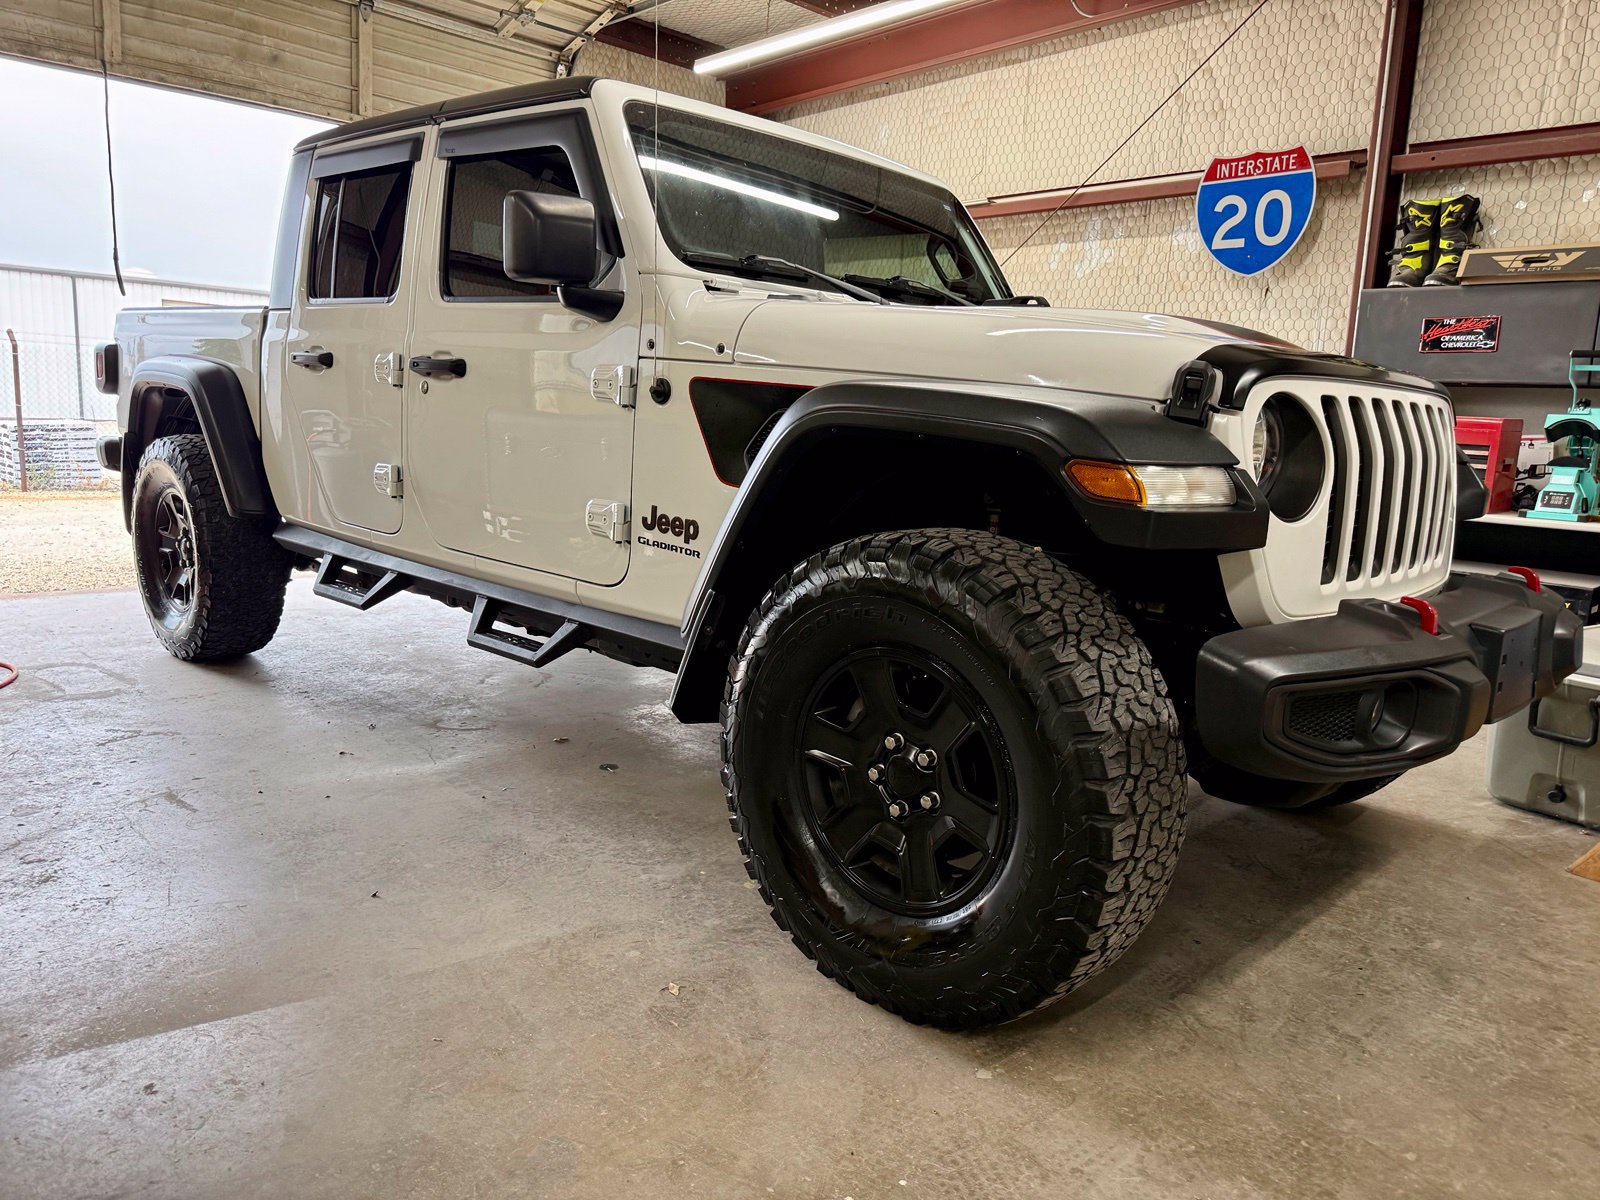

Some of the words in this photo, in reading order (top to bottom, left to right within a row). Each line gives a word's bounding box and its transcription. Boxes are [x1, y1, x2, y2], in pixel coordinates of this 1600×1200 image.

[1216, 153, 1298, 179] INTERSTATE
[1211, 189, 1292, 250] 20
[641, 504, 699, 544] Jeep
[637, 535, 701, 559] GLADIATOR
